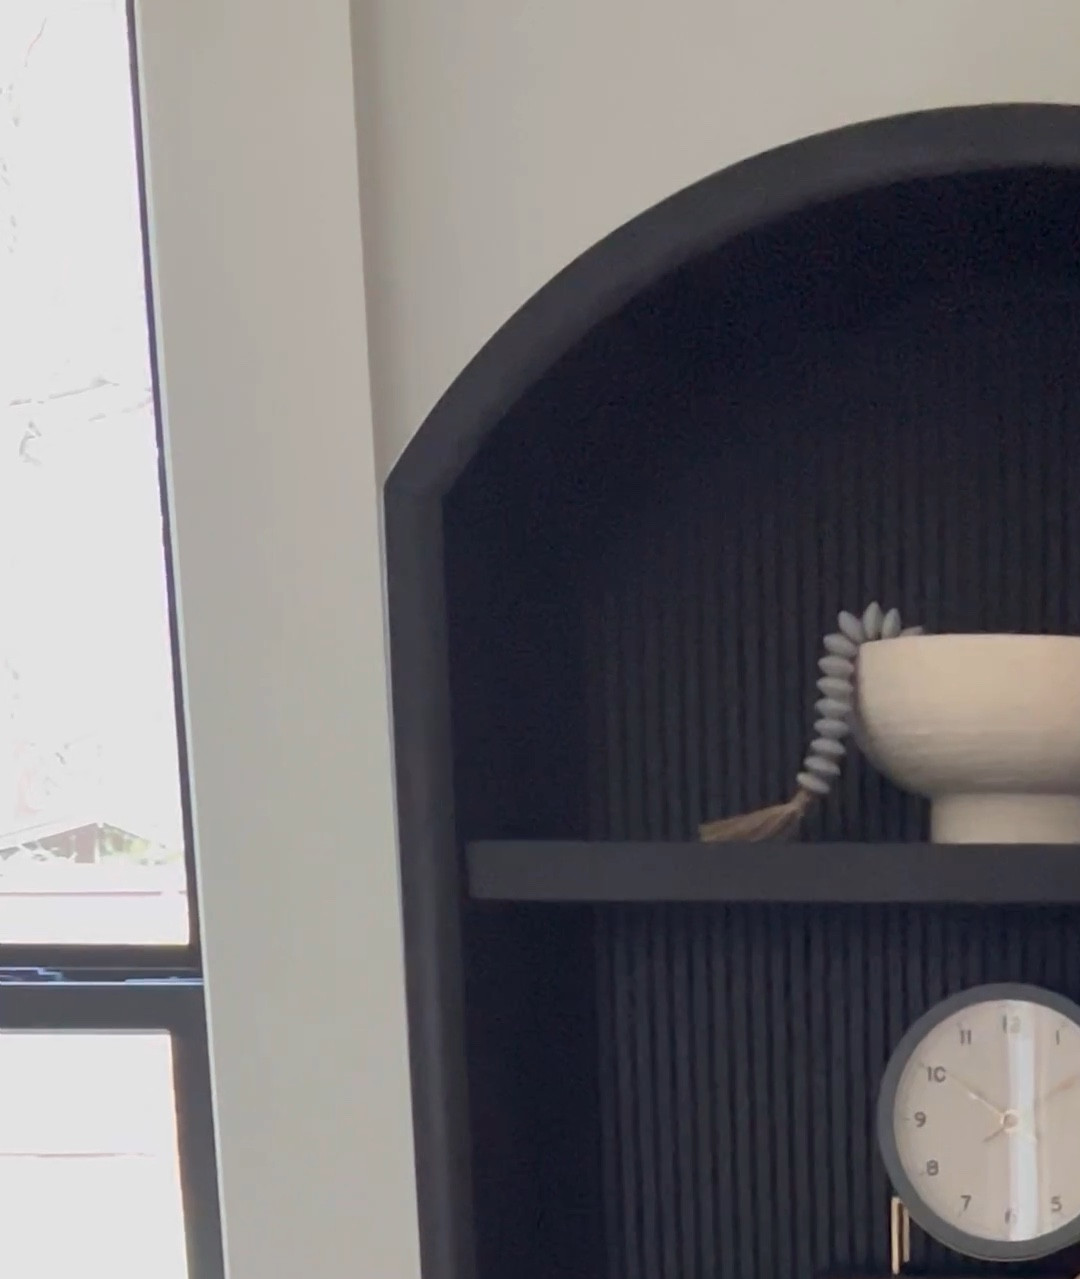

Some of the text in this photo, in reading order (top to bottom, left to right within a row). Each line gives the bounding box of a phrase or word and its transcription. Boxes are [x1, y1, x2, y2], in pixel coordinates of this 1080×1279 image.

[1003, 1016, 1020, 1033] 12
[961, 1030, 972, 1045] 11
[914, 1111, 926, 1127] 9
[926, 1160, 939, 1176] 8
[961, 1195, 972, 1212] 7
[1051, 1196, 1062, 1213] 5
